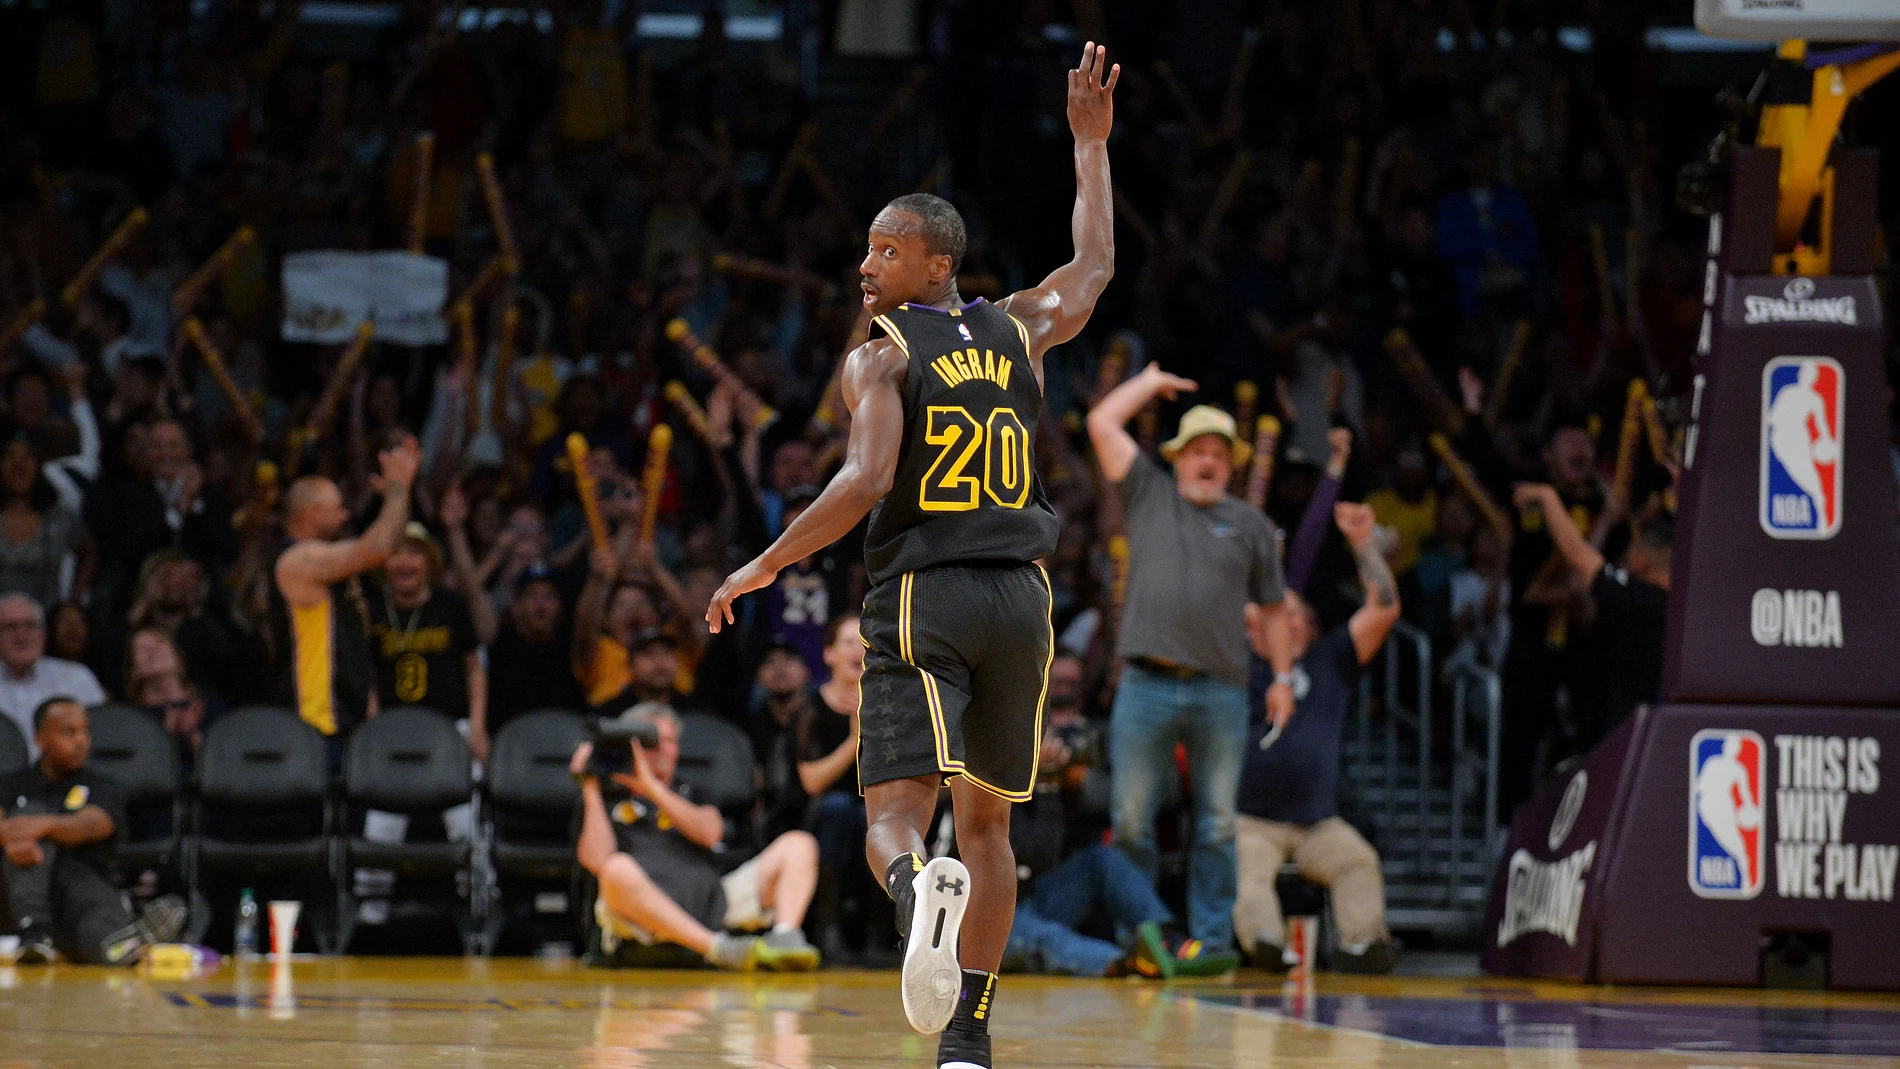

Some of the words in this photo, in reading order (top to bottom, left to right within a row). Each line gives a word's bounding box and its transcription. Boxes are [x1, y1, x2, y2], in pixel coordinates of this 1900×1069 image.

[1744, 295, 1857, 325] SPALDING
[930, 348, 1013, 391] INGRAM
[919, 406, 1029, 511] 20
[1772, 493, 1813, 525] NBA
[1751, 587, 1844, 648] @NBA
[1774, 734, 1846, 790] THIS
[1847, 736, 1881, 794] IS
[1776, 789, 1848, 842] WHY
[1497, 839, 1598, 948] SPALDING
[1700, 856, 1736, 886] NBA
[1775, 841, 1823, 898] WE
[1824, 841, 1899, 901] PLAY
